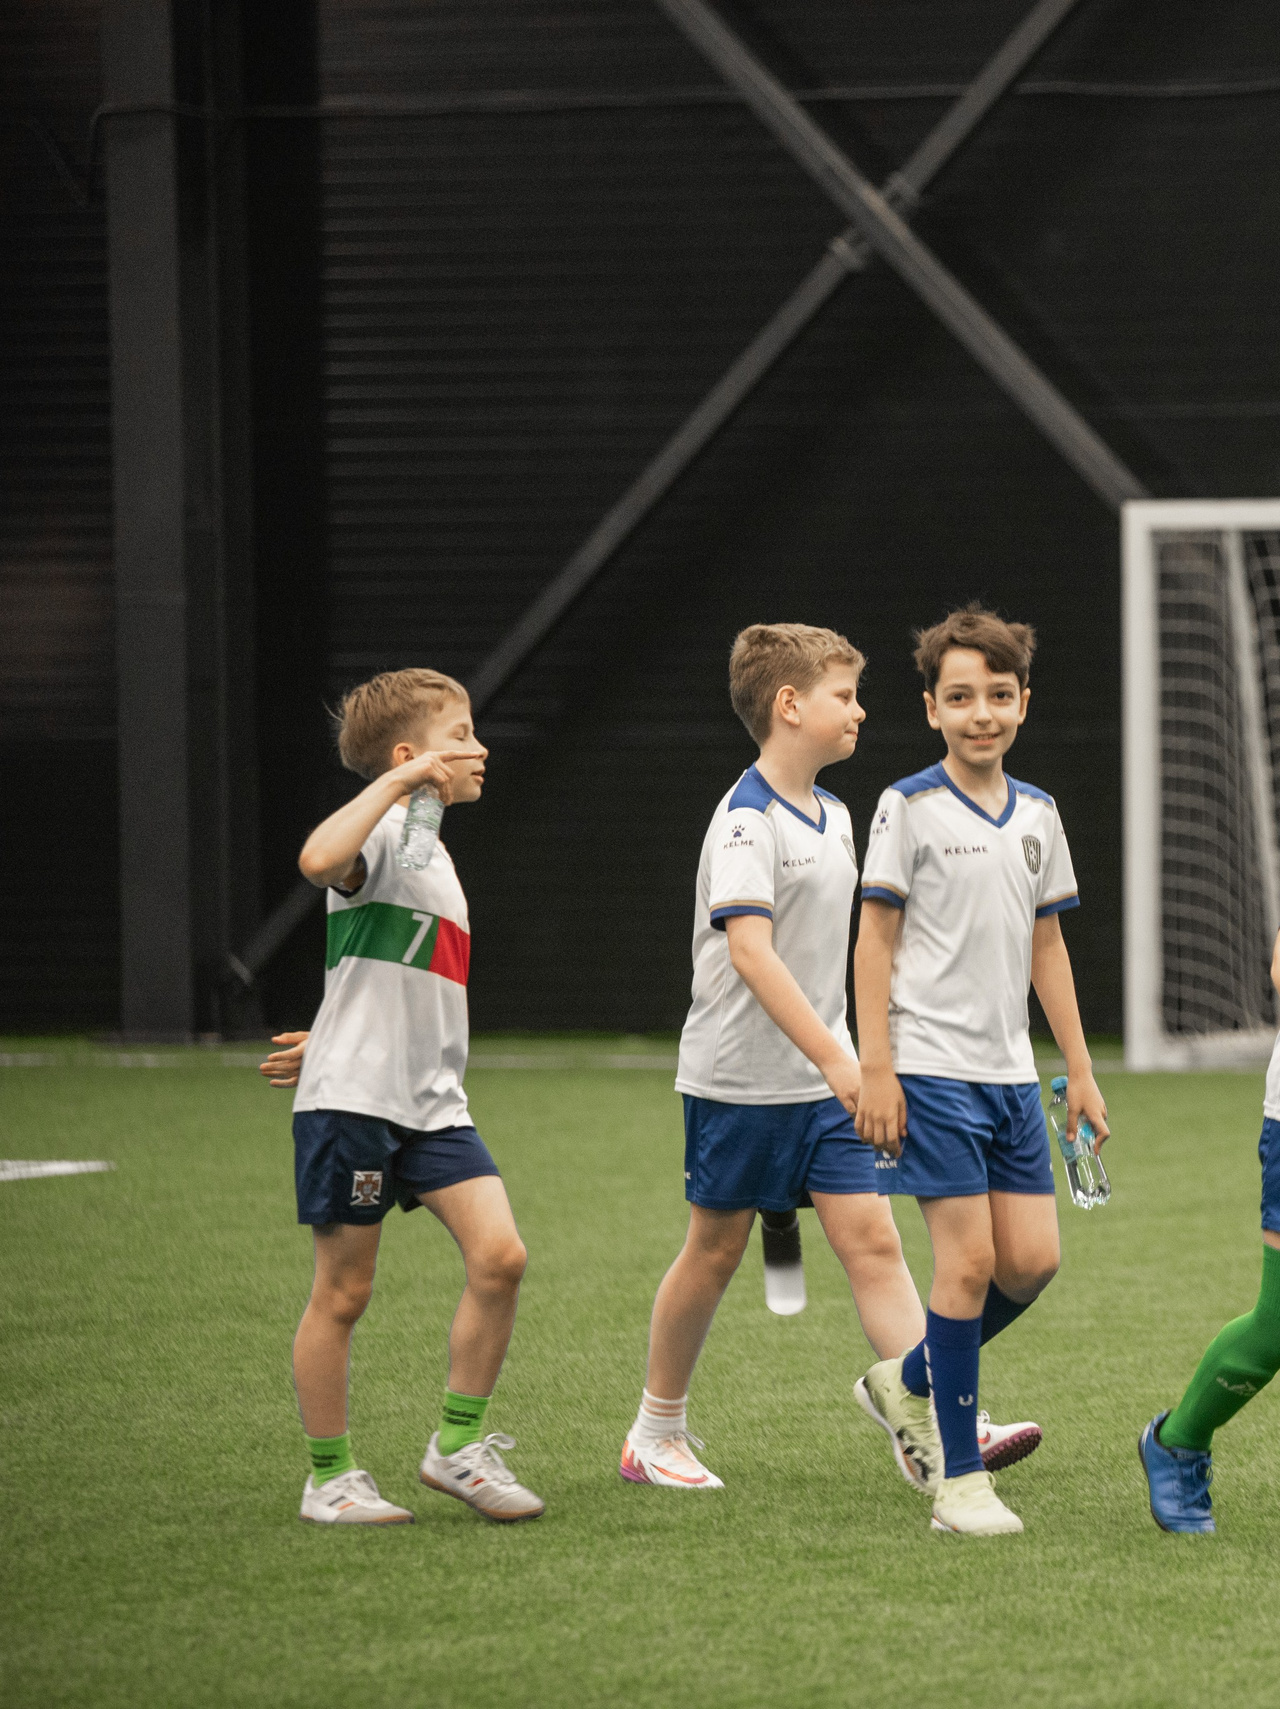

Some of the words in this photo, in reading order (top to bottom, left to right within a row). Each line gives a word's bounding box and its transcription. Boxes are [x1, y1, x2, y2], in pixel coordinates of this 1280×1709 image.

[723, 840, 755, 850] KELME
[944, 844, 989, 857] KELME
[782, 856, 817, 868] KELME
[401, 909, 434, 965] 7
[874, 1159, 898, 1170] KELME
